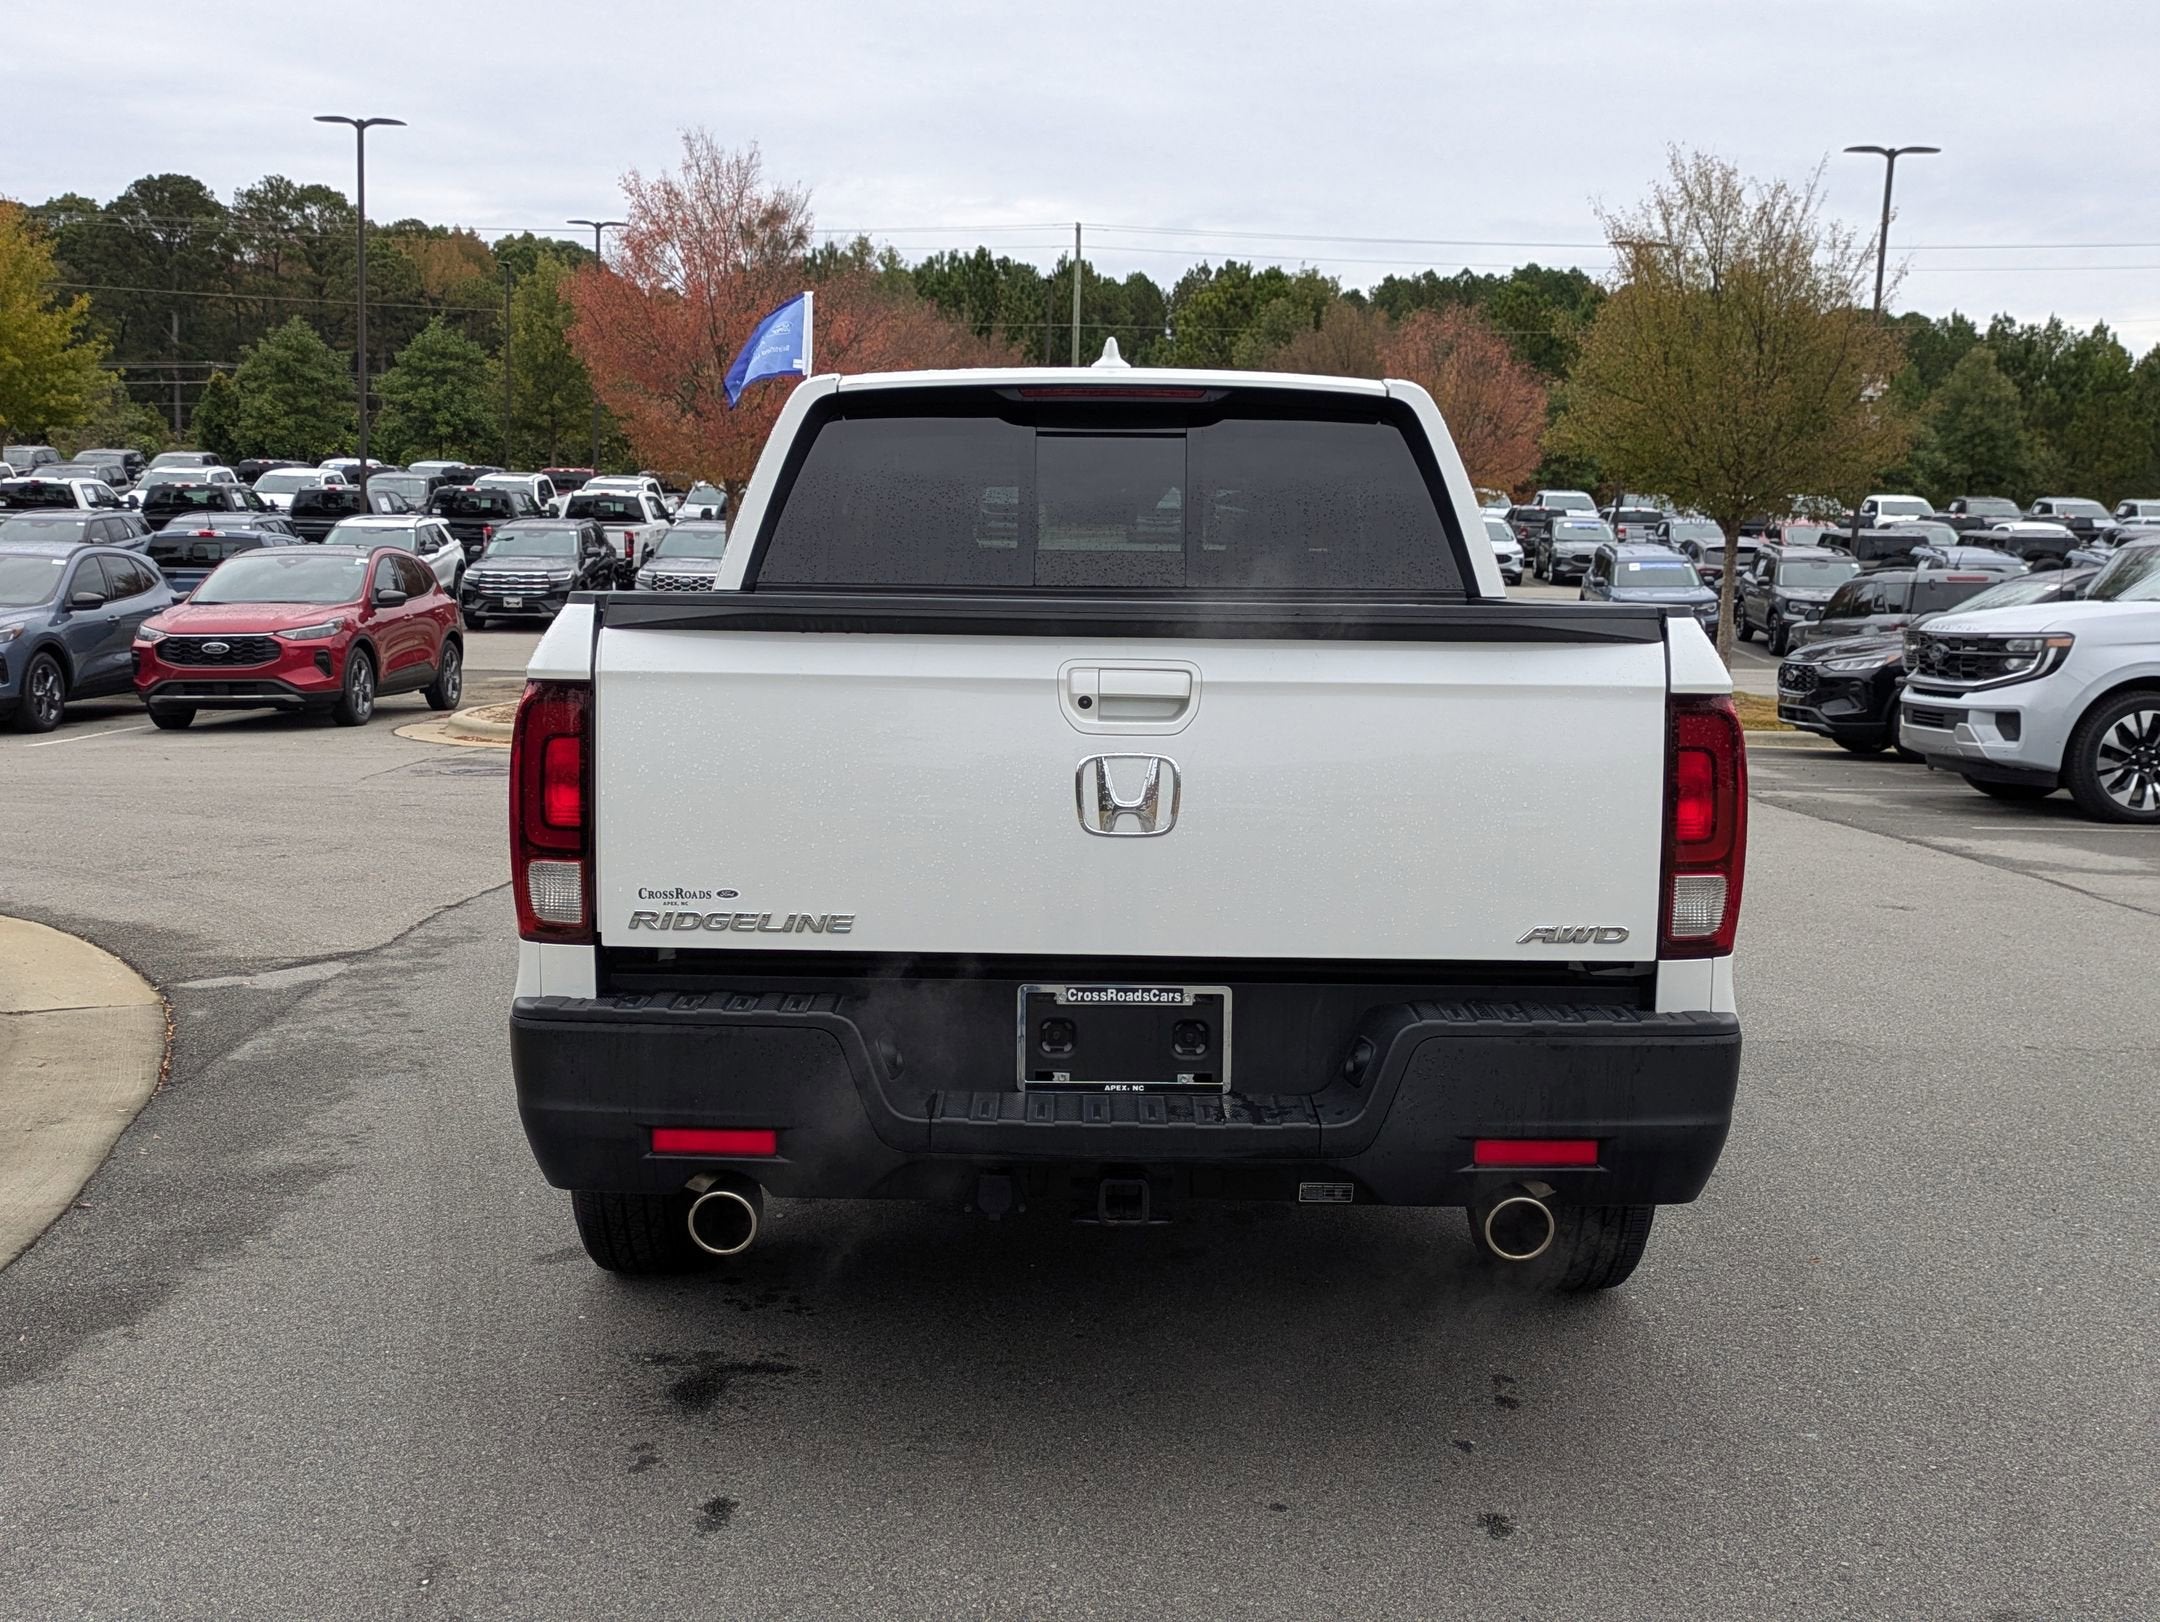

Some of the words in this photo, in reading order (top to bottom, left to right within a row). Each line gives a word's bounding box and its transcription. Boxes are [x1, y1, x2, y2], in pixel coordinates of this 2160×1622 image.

[628, 910, 856, 934] RIDGELINE
[1515, 925, 1630, 944] AWD
[1067, 988, 1182, 1002] CrossRoadsCars
[1132, 1084, 1144, 1092] NC
